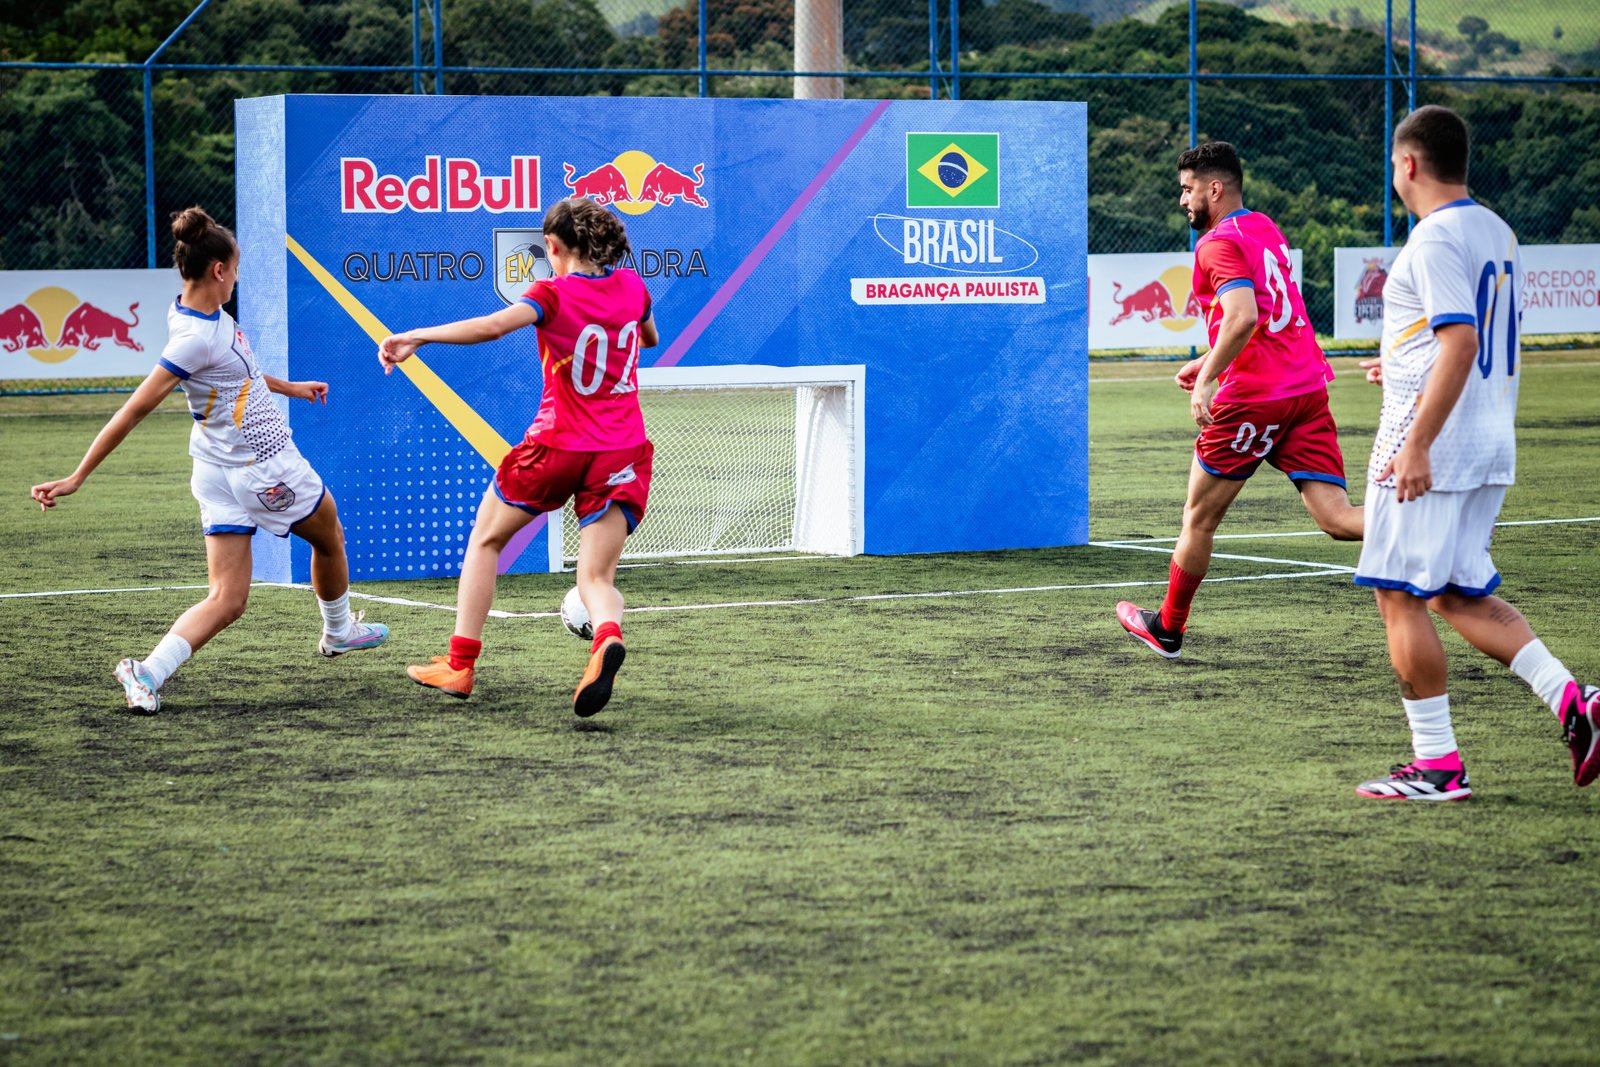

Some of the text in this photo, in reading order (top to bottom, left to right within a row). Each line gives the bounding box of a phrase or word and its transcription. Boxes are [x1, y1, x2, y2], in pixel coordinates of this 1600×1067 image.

[341, 156, 541, 213] Red Bull
[903, 219, 1003, 264] BRASIL
[343, 248, 708, 282] QUATRO EM ADRA
[866, 281, 1039, 300] BRAGANÇA PAULISTA
[571, 320, 637, 396] 02
[1230, 422, 1279, 457] 05
